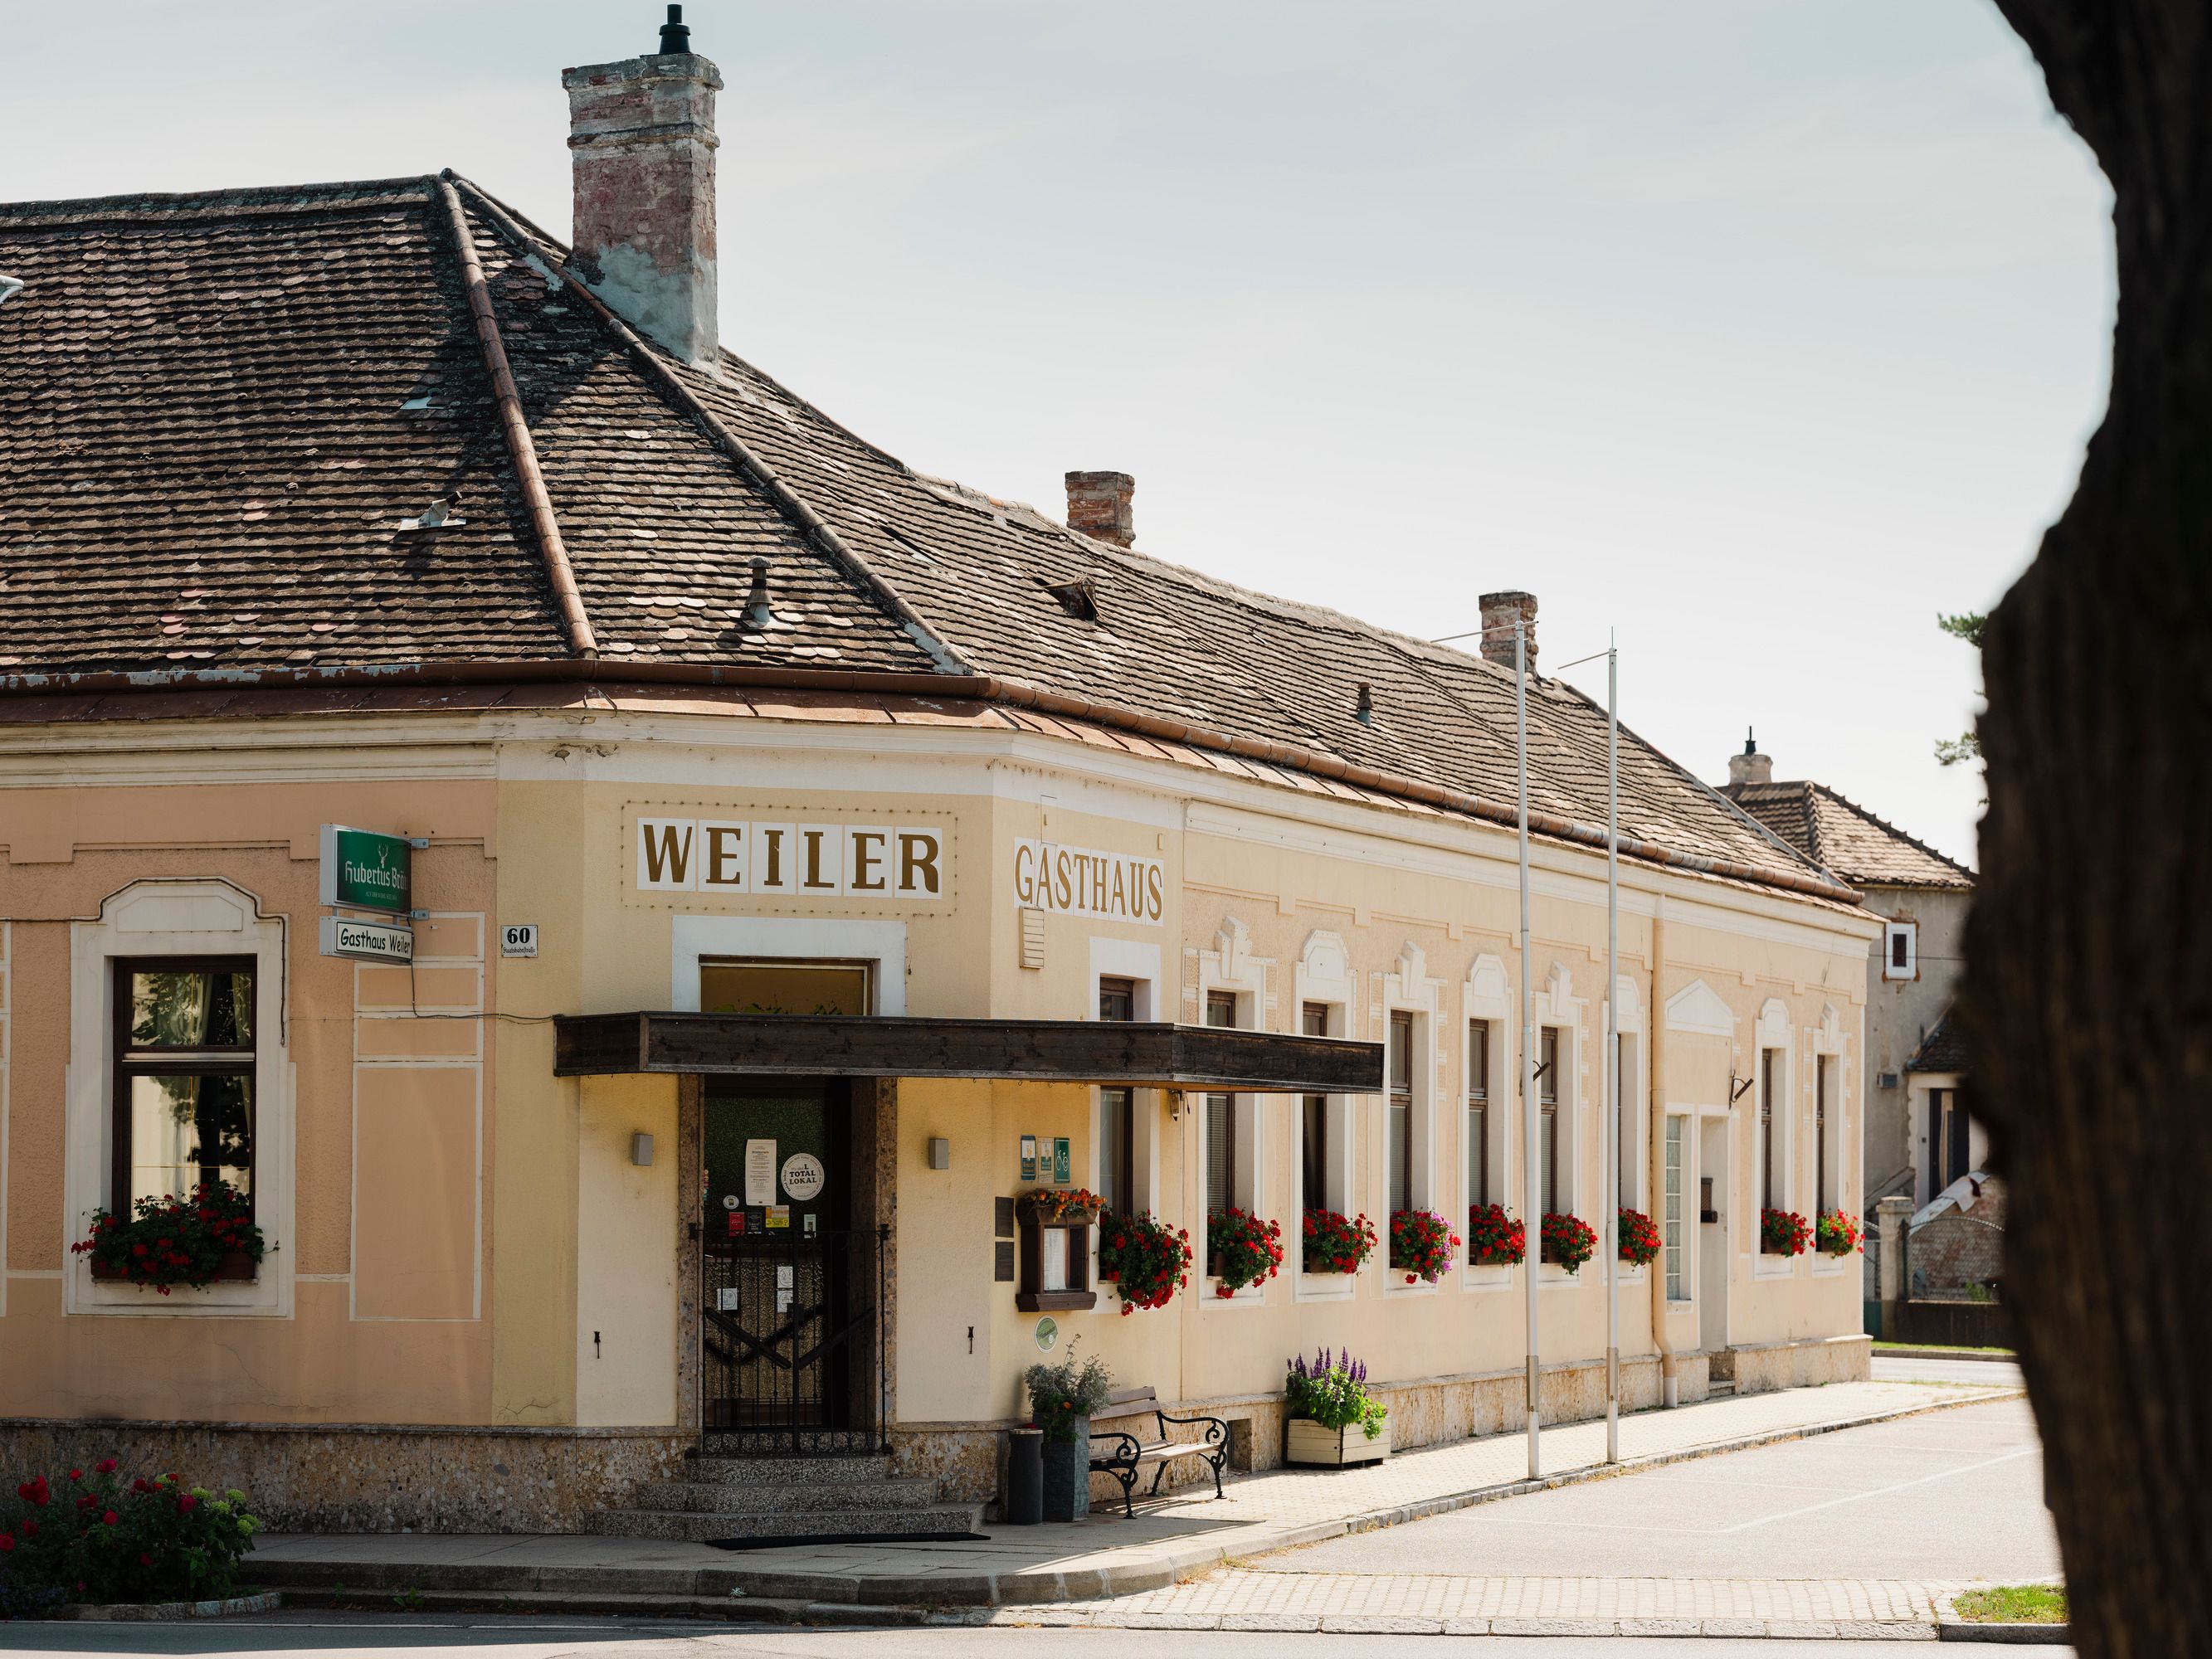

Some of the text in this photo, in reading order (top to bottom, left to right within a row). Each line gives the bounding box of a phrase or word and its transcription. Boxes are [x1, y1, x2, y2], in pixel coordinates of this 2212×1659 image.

[643, 824, 939, 893] WEILER
[345, 860, 391, 887] Hubertus
[1015, 843, 1163, 922] GASTHAUS
[341, 927, 410, 955] Gasthaus Weiler
[507, 927, 530, 944] 60
